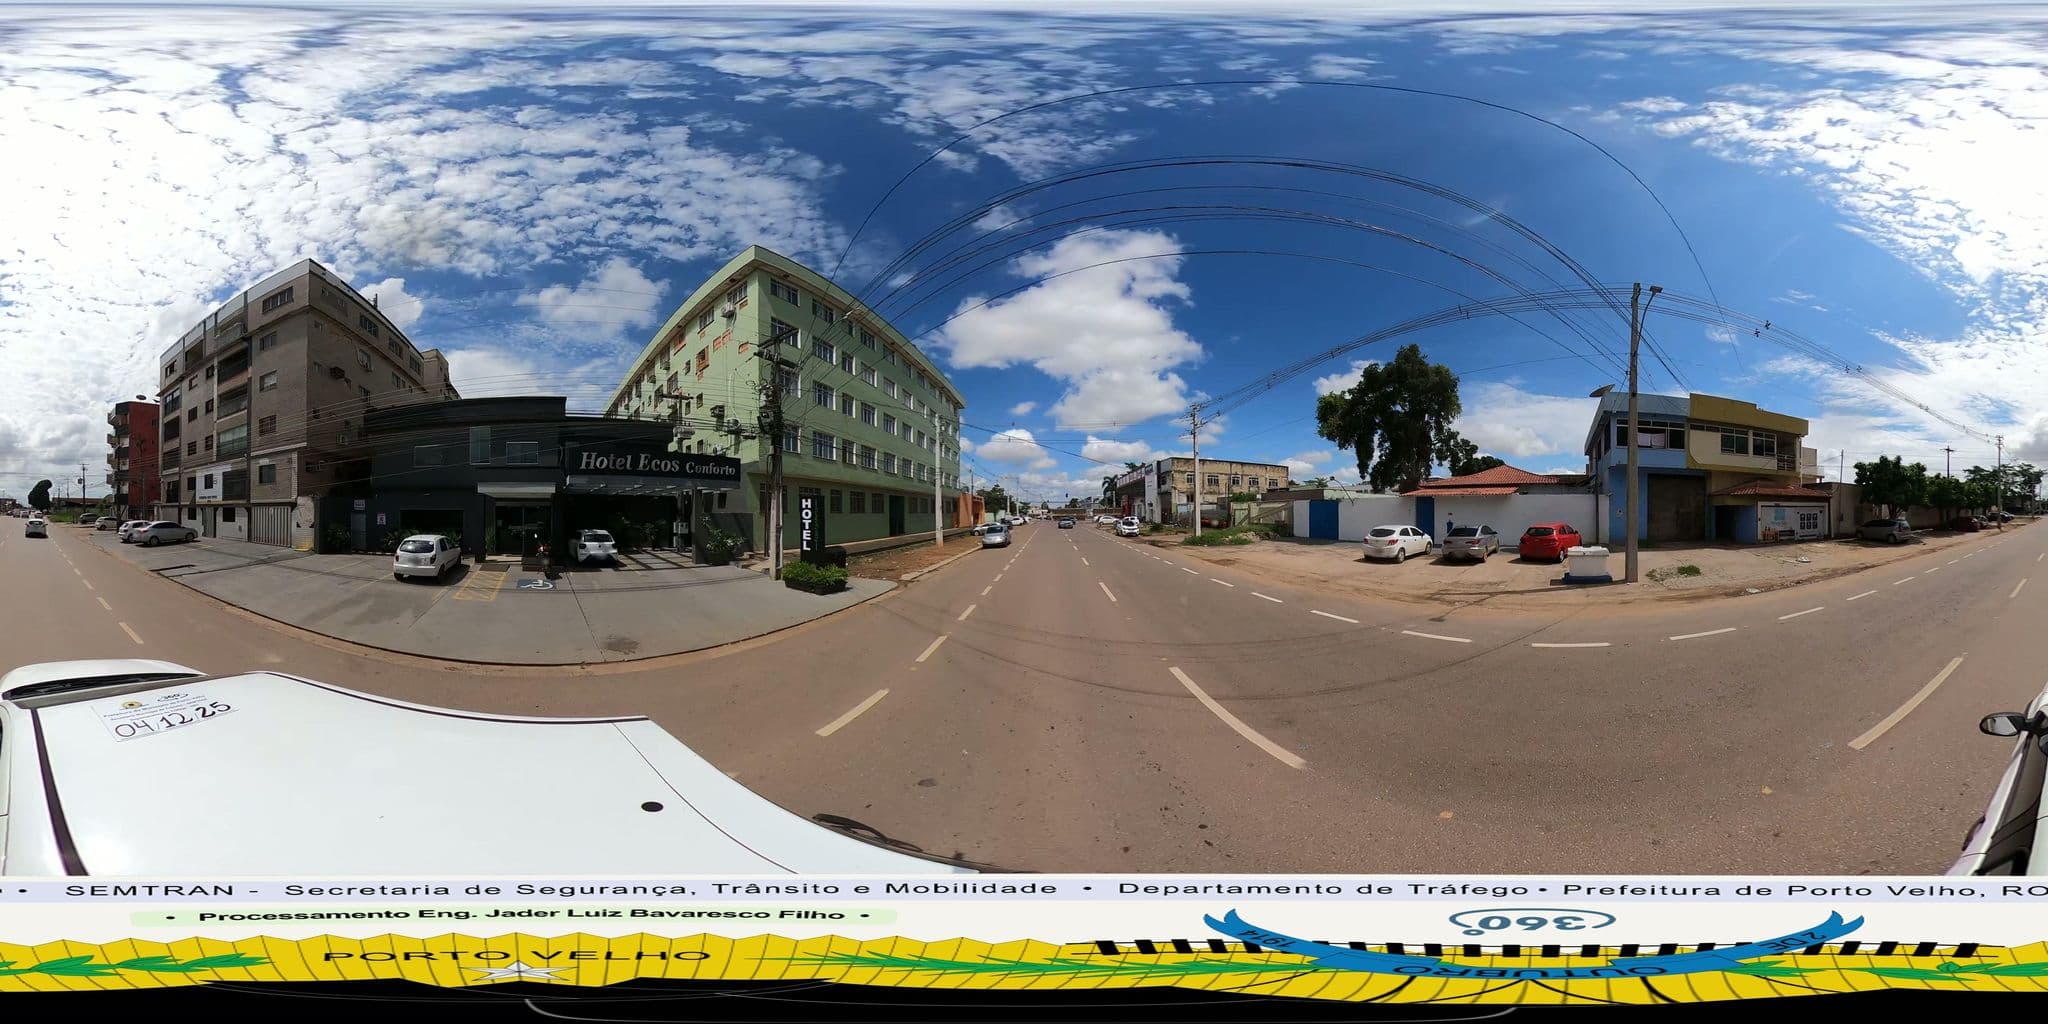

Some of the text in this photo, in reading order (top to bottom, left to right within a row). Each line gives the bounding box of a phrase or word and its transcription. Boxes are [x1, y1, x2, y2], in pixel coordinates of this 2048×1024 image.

[580, 452, 736, 476] Hotel Ecos Conforto
[802, 498, 812, 551] HOTEL
